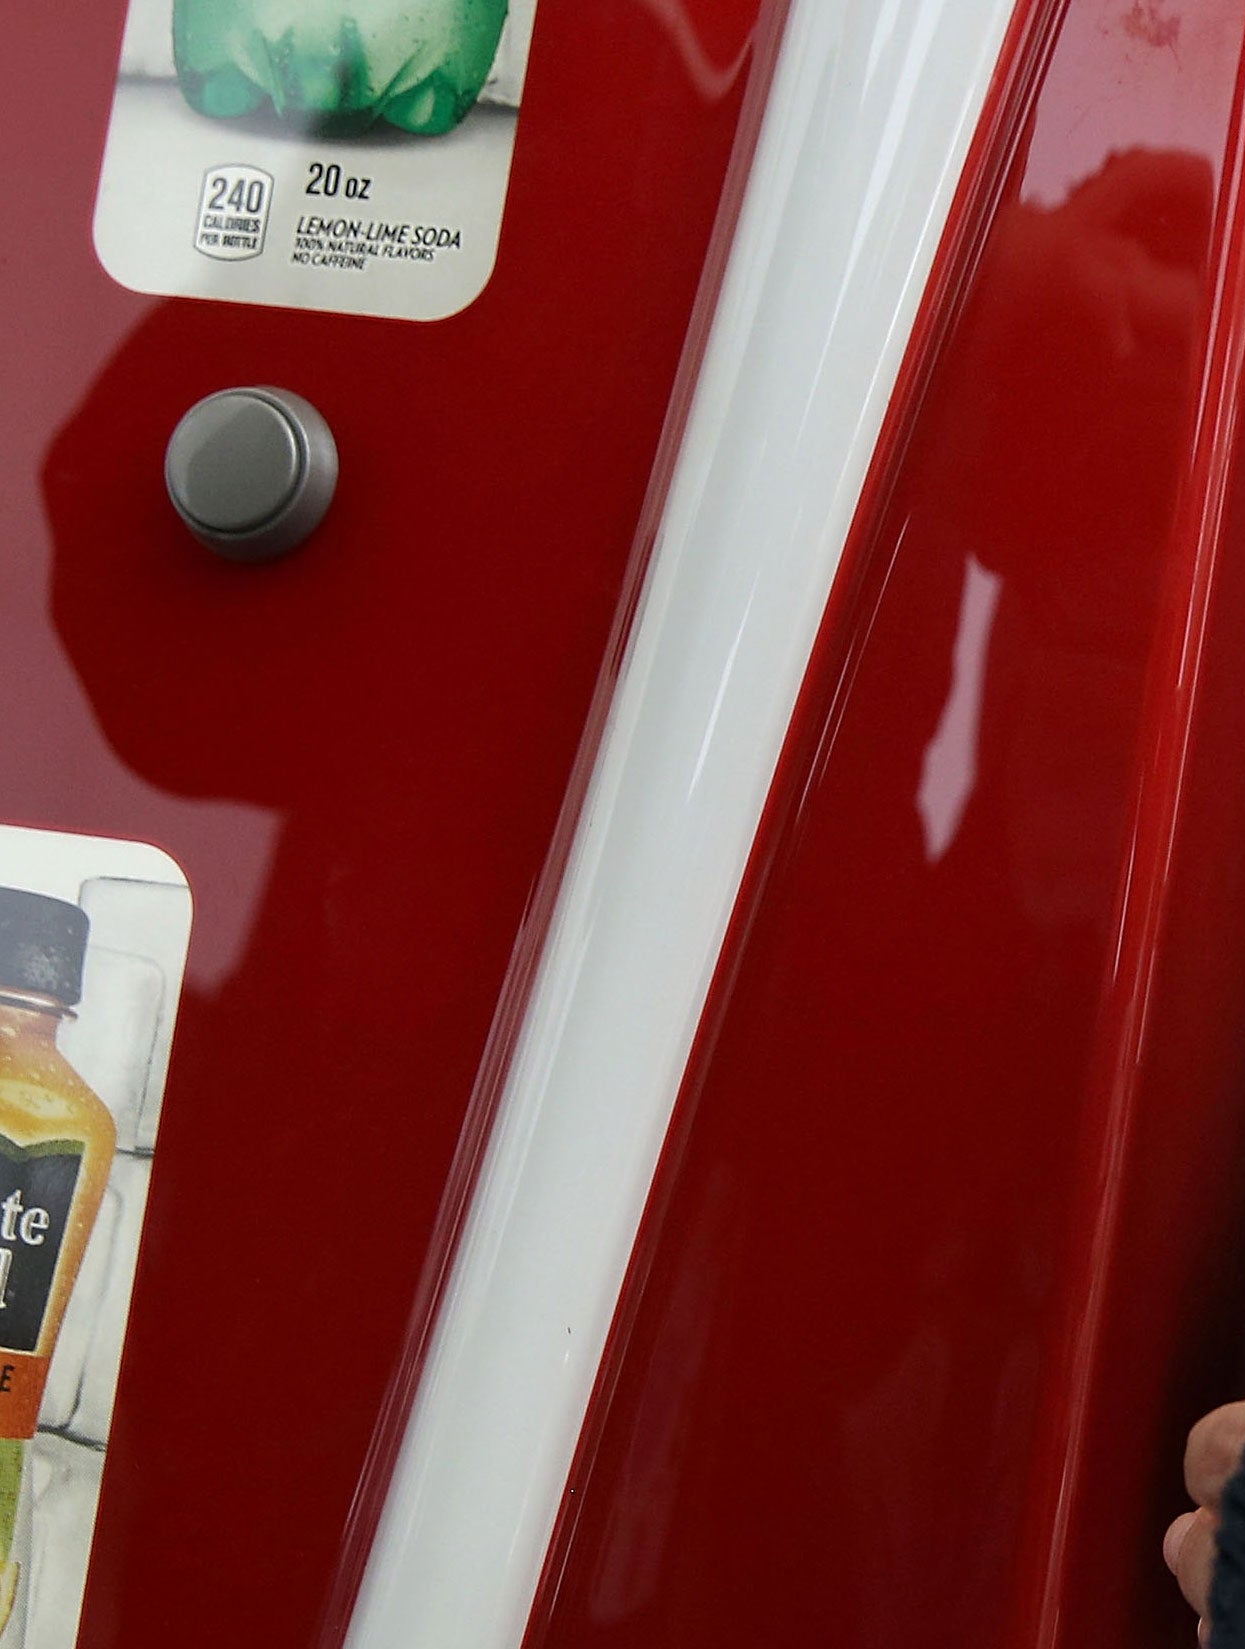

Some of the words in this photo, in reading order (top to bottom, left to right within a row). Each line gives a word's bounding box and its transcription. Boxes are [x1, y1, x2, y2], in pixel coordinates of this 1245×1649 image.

[208, 177, 264, 213] 240
[305, 163, 341, 196] 20
[345, 178, 371, 200] oz
[296, 216, 410, 244] LEMON-LIME
[411, 226, 462, 249] SODA
[292, 251, 310, 265] NO
[311, 253, 367, 270] CAFFEINE
[327, 240, 379, 256] NATURAL
[381, 244, 435, 262] FLAVORS
